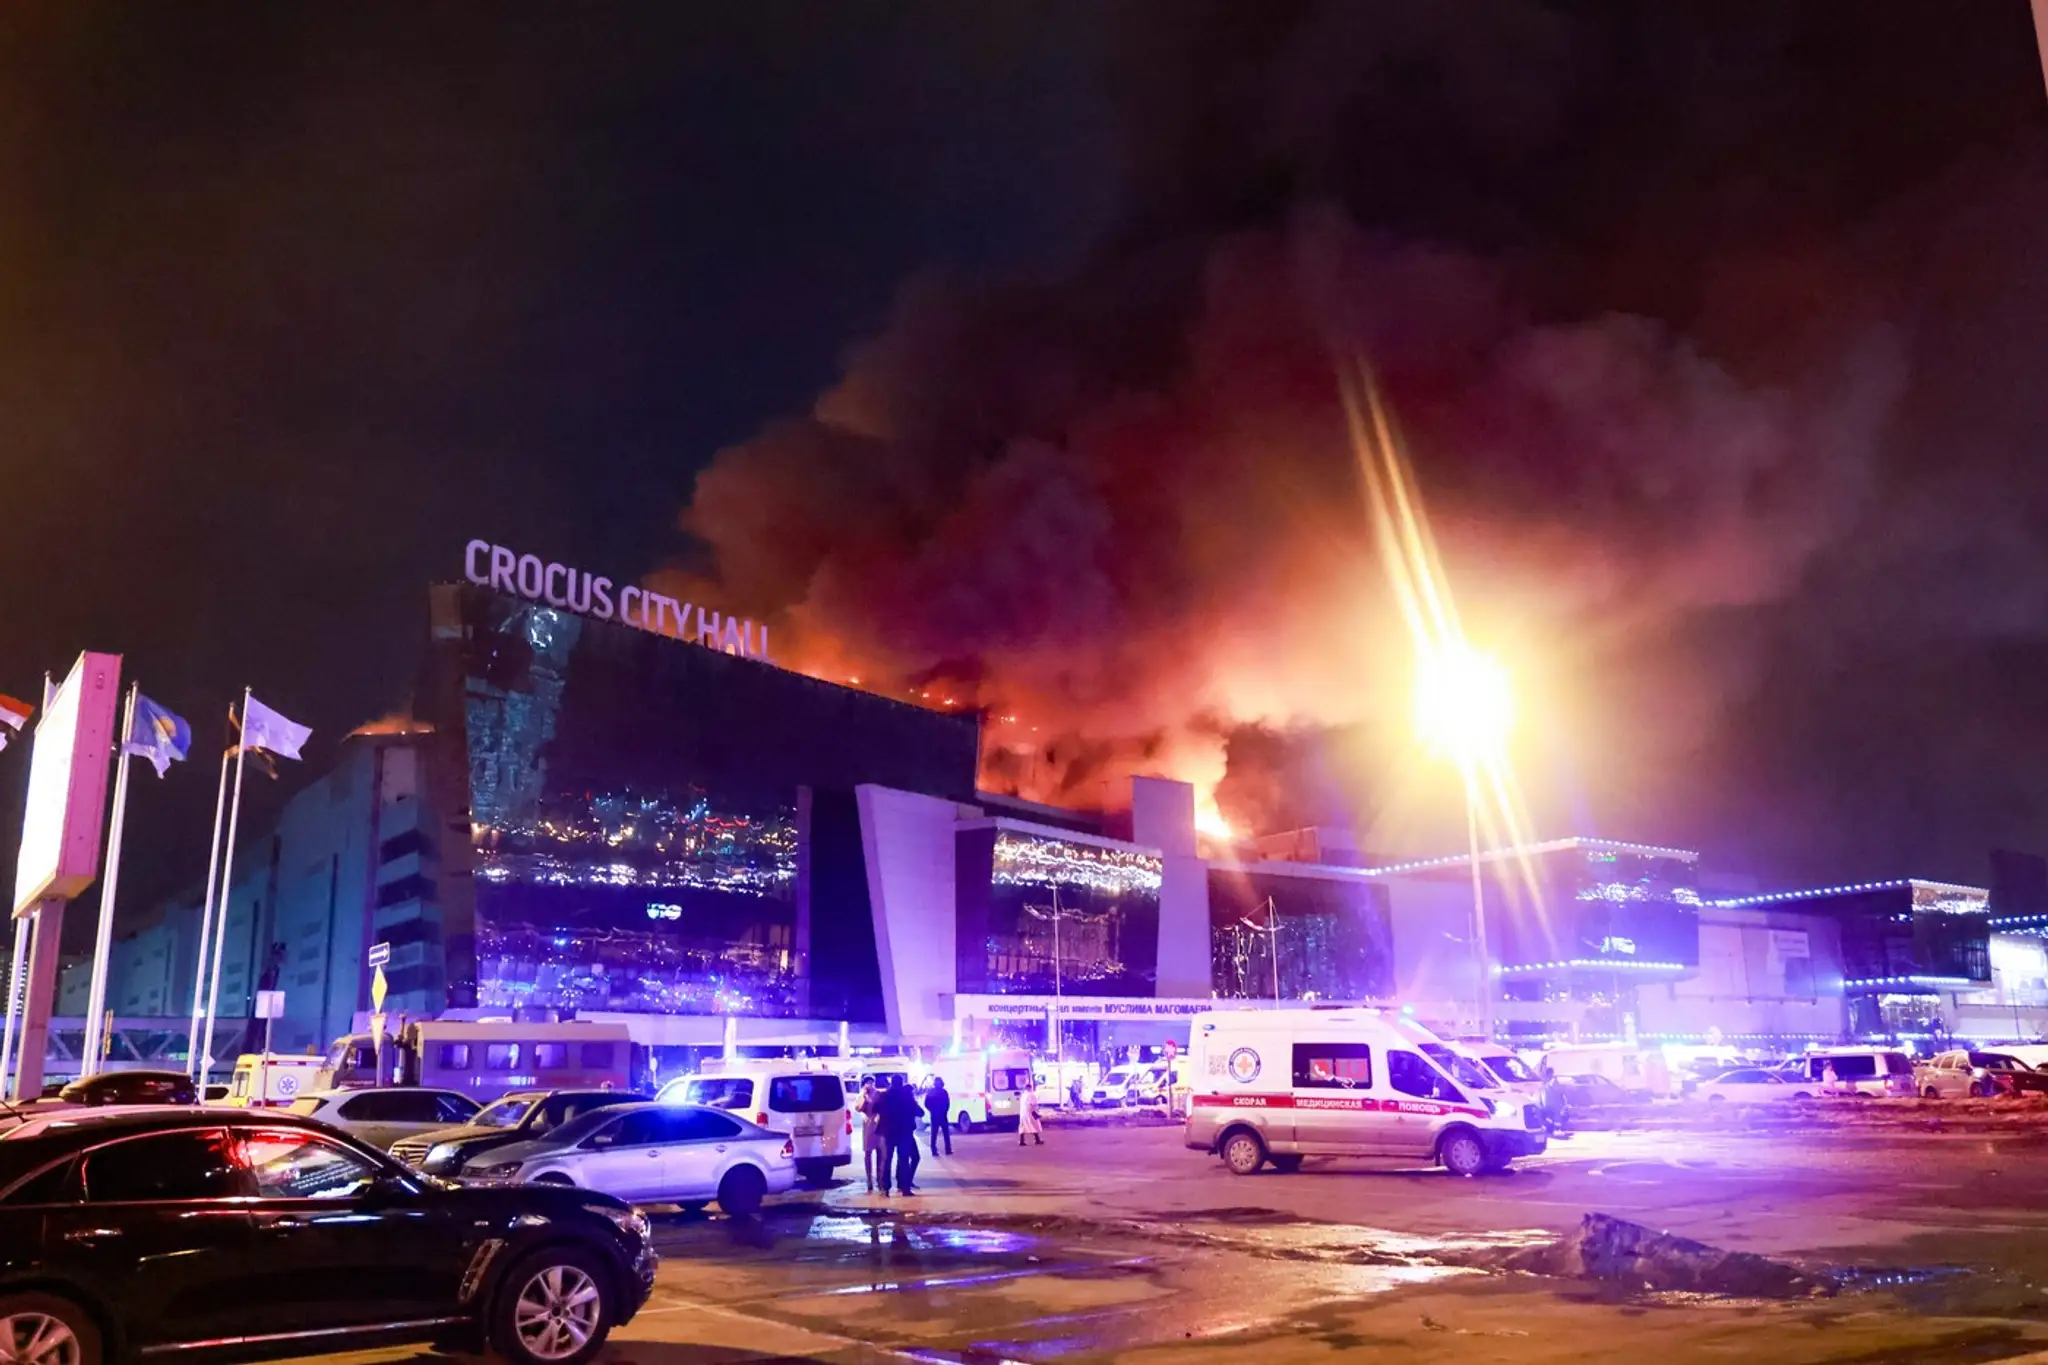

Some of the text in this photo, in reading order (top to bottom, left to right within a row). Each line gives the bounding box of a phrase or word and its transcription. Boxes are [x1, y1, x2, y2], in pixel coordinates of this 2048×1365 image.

[464, 538, 776, 662] CROCUS CITY HALL
[1105, 1003, 1153, 1014] МУСЛИМА
[1233, 1097, 1441, 1114] СКОРАЯ МЕДИЦИНСКАЯ ПОМОЩЬ
